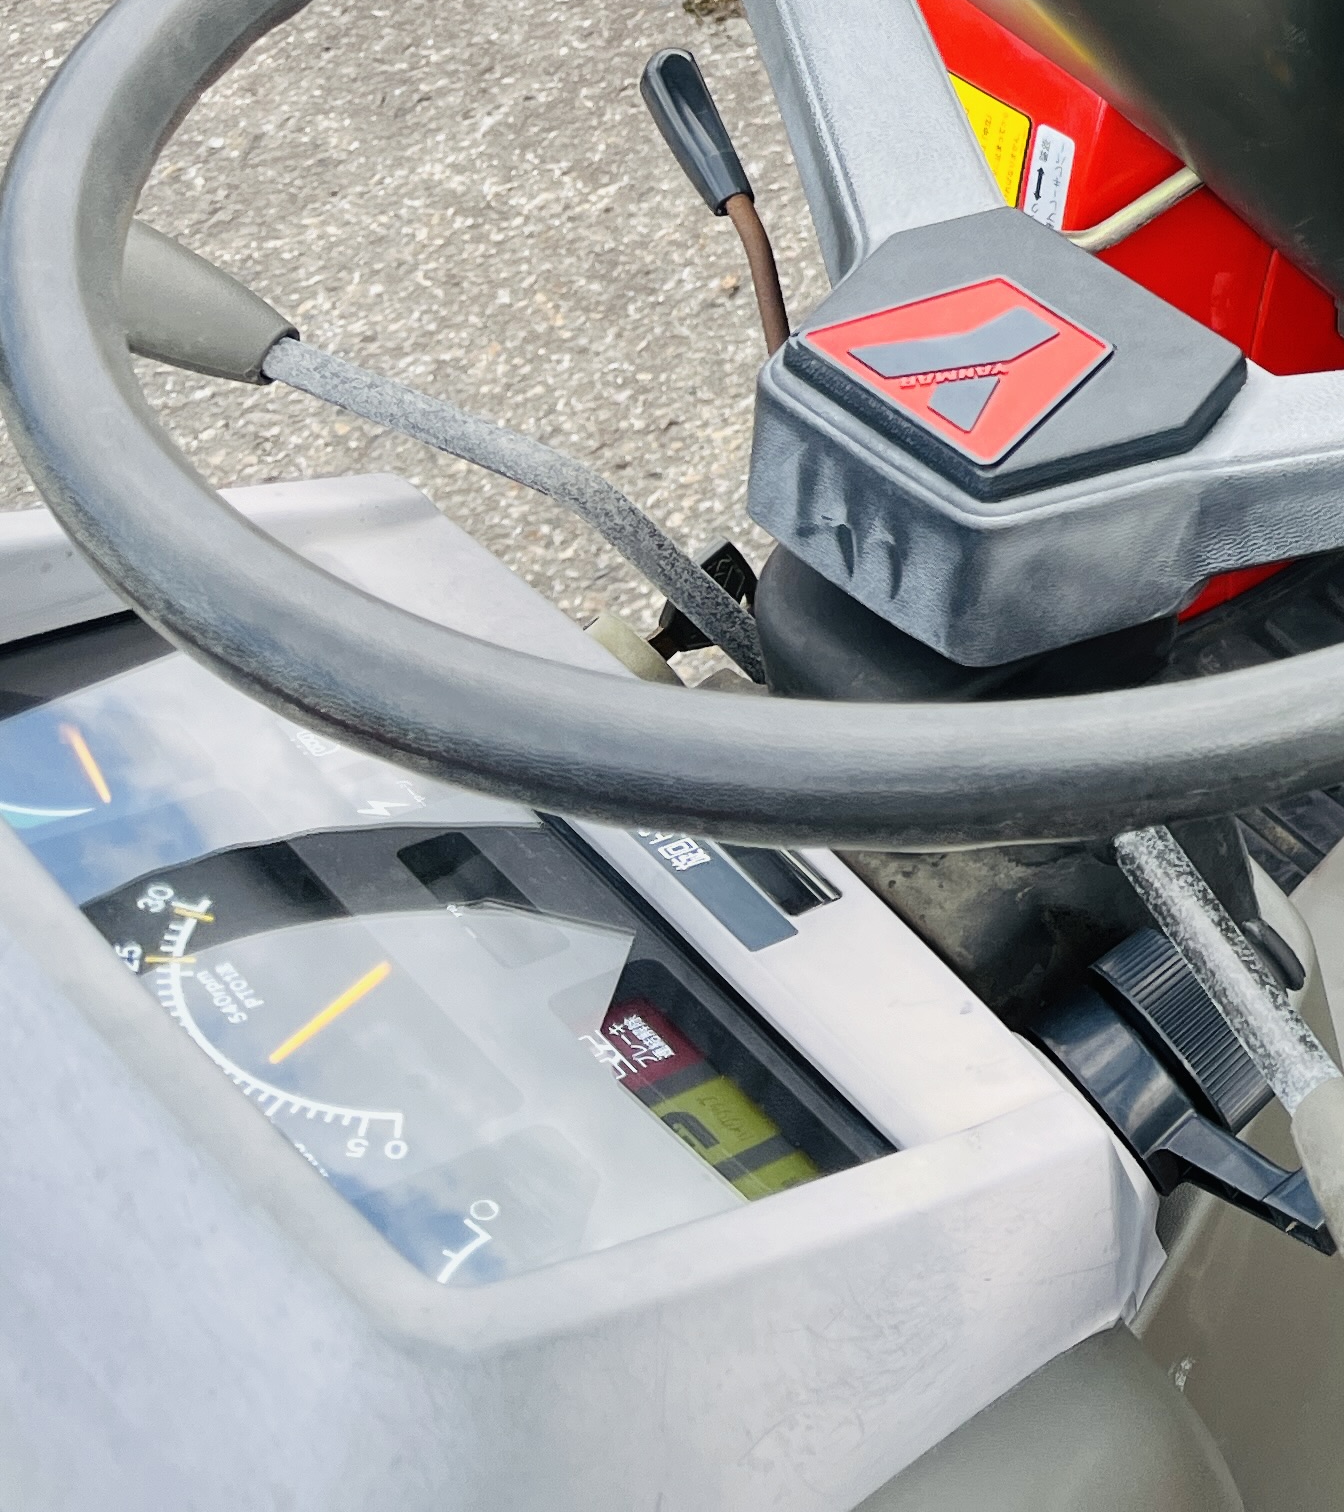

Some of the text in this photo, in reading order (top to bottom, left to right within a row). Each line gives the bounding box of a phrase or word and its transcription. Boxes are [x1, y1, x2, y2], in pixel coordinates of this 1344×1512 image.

[900, 363, 1009, 389] YANMAR
[136, 883, 174, 913] 30
[196, 970, 248, 1024] 540rpm
[608, 1022, 656, 1068] ブレーキ
[345, 1138, 369, 1158] 5
[384, 1139, 408, 1160] 0
